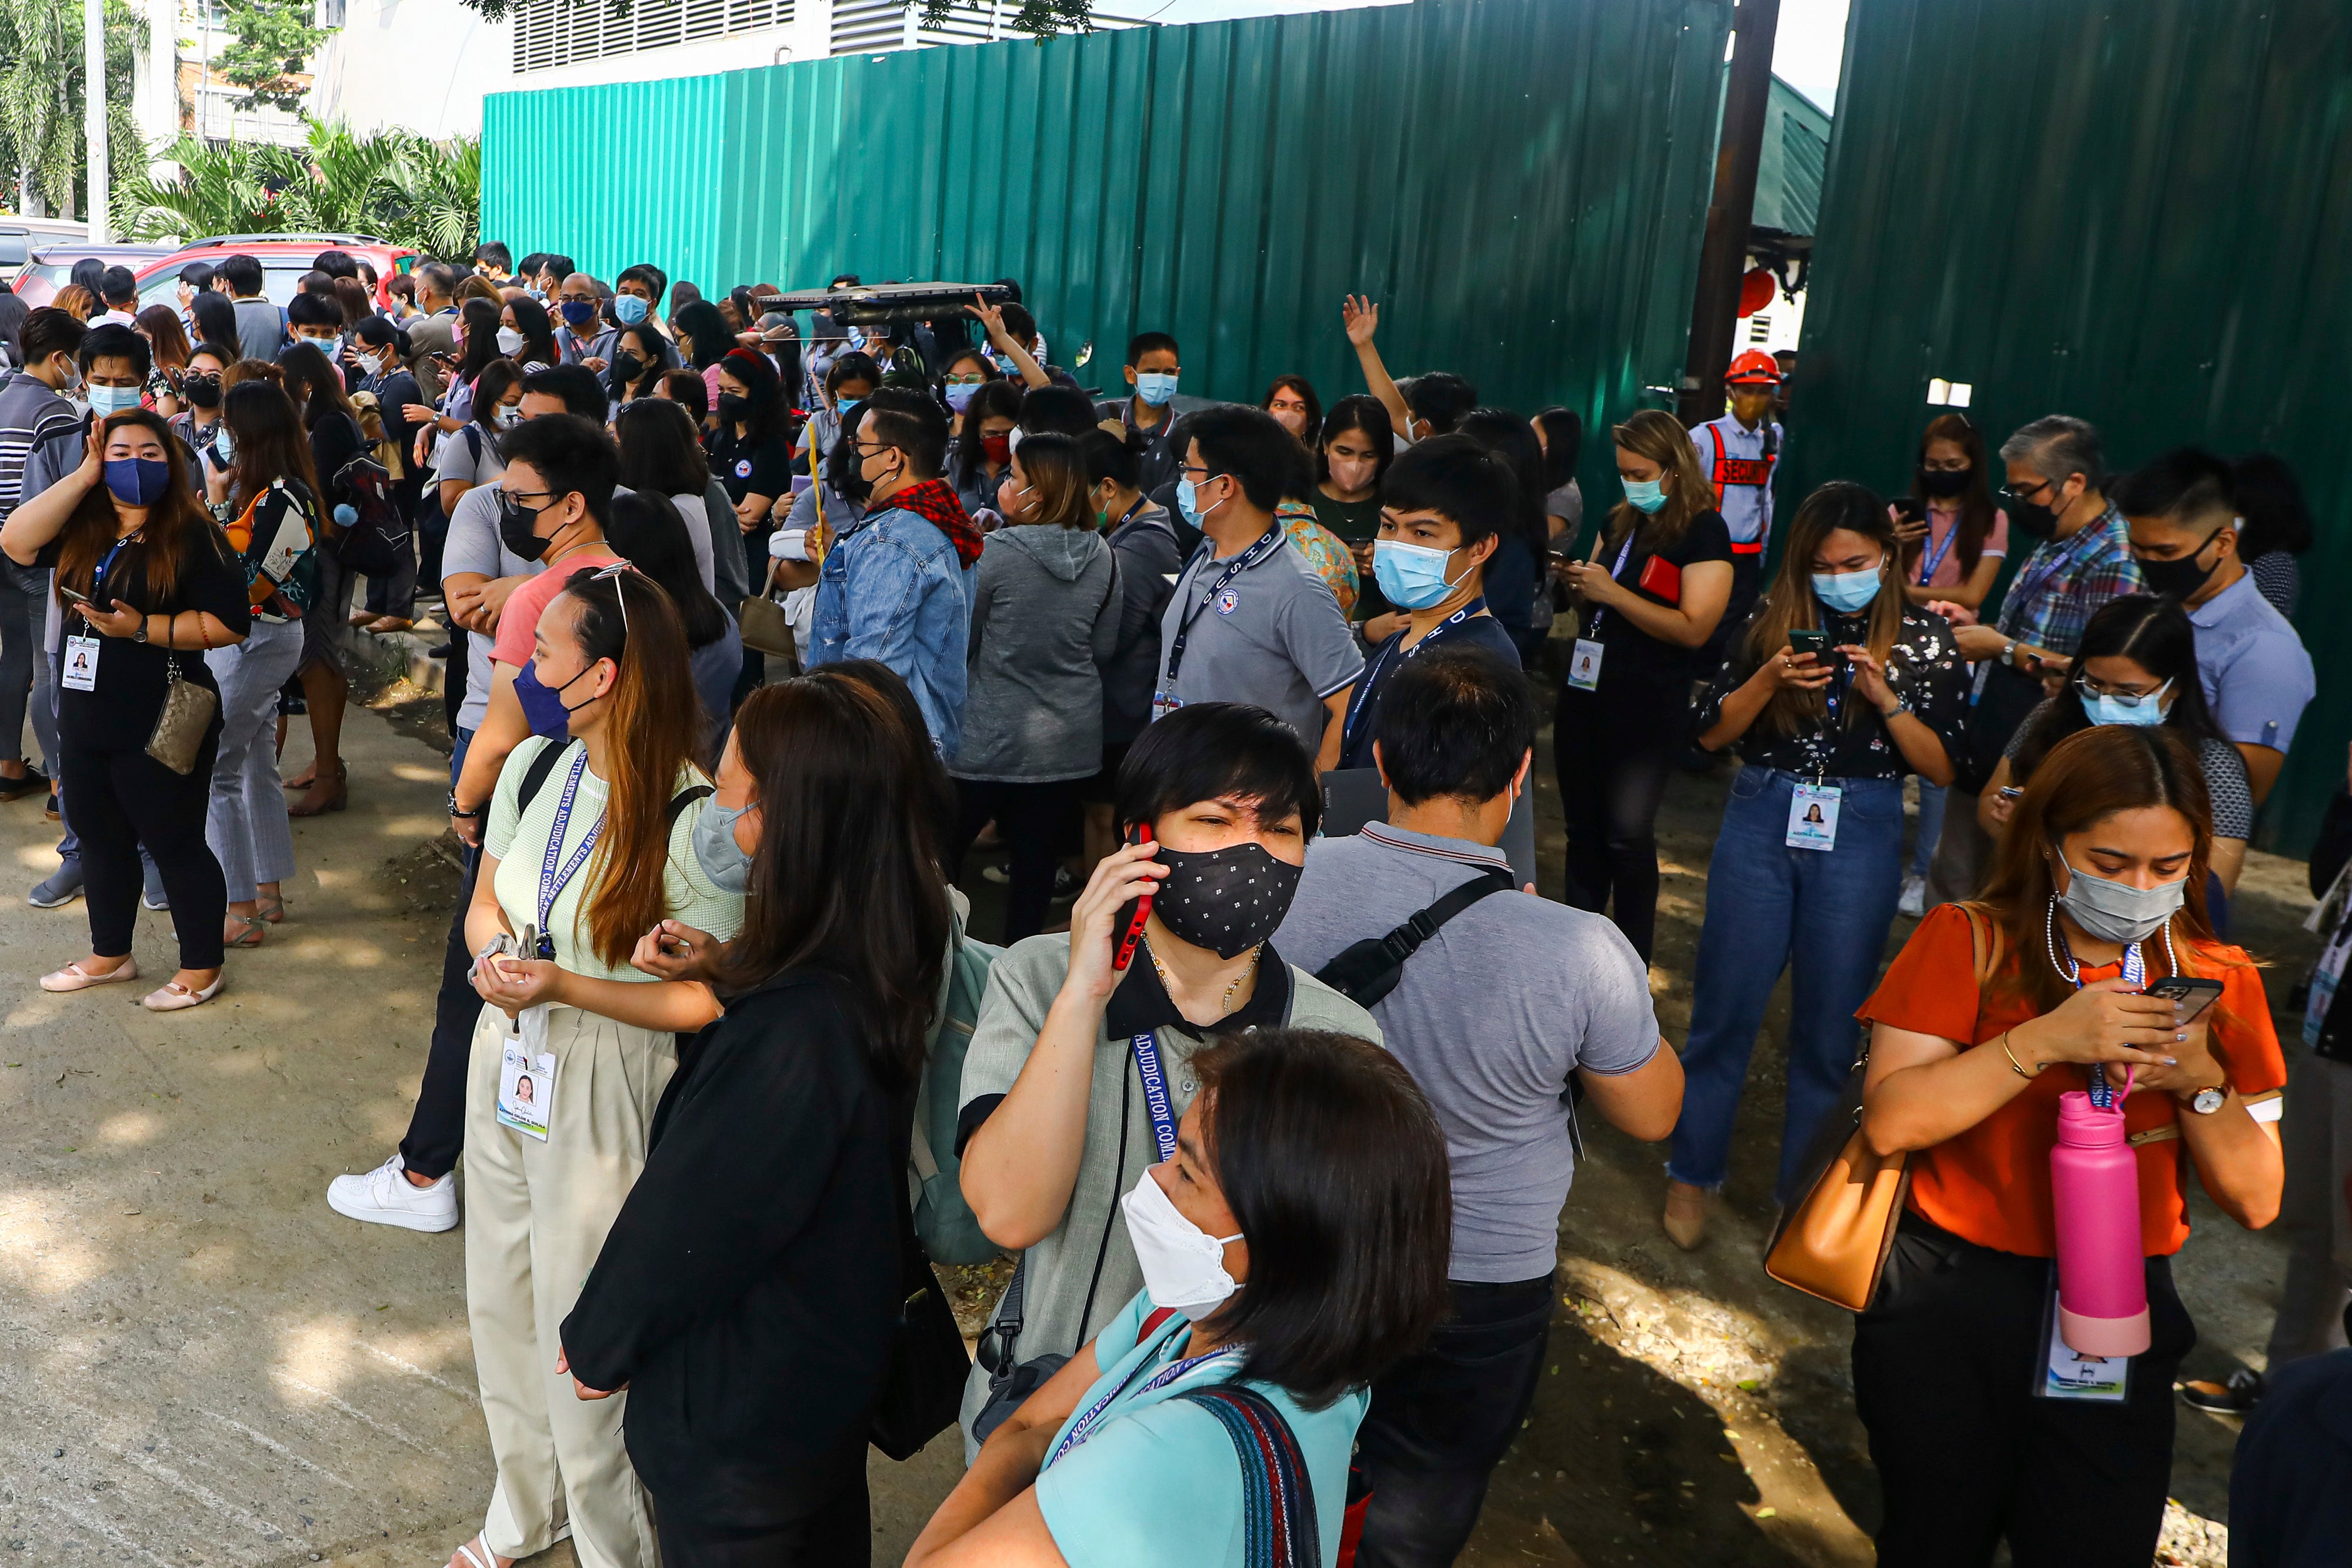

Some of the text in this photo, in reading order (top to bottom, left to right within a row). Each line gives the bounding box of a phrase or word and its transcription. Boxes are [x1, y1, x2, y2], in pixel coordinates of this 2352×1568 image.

[1203, 533, 1272, 605] DHSUD
[561, 750, 587, 808] SETTLEMENTS
[545, 809, 568, 872] ADJUDICATION
[548, 846, 588, 900] SETTLEMENTS
[1135, 1034, 1170, 1122] ADJUDICATION
